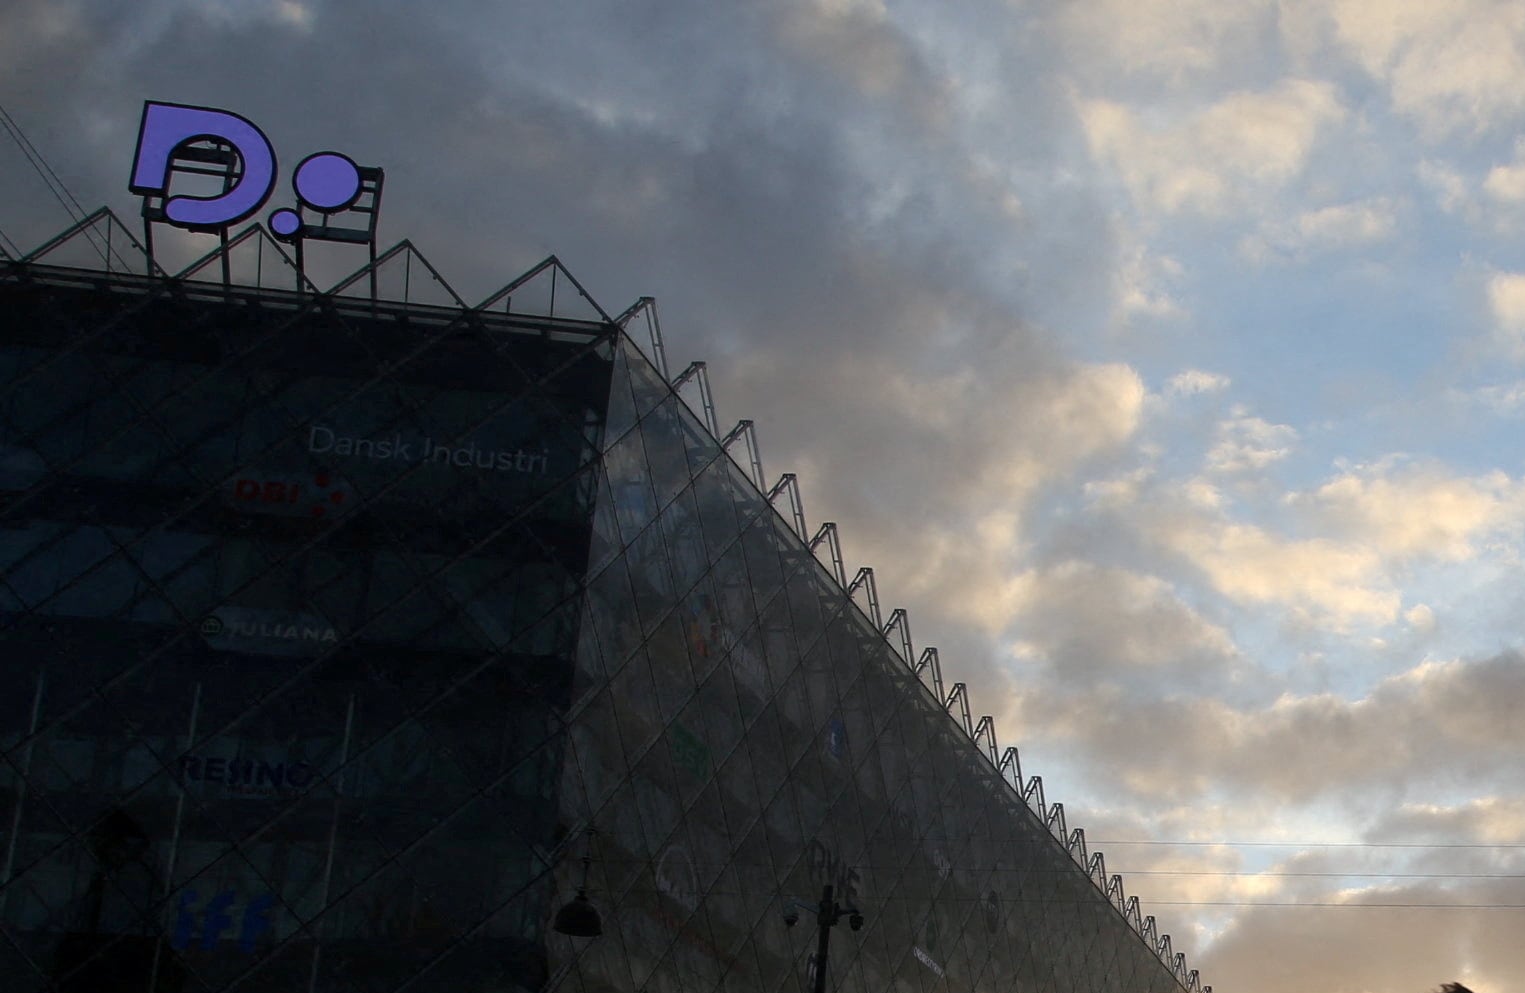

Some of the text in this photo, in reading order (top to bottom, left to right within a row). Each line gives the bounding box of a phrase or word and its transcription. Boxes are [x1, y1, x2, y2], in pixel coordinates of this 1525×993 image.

[309, 425, 550, 475] Dansk Industri
[234, 479, 300, 504] DBI
